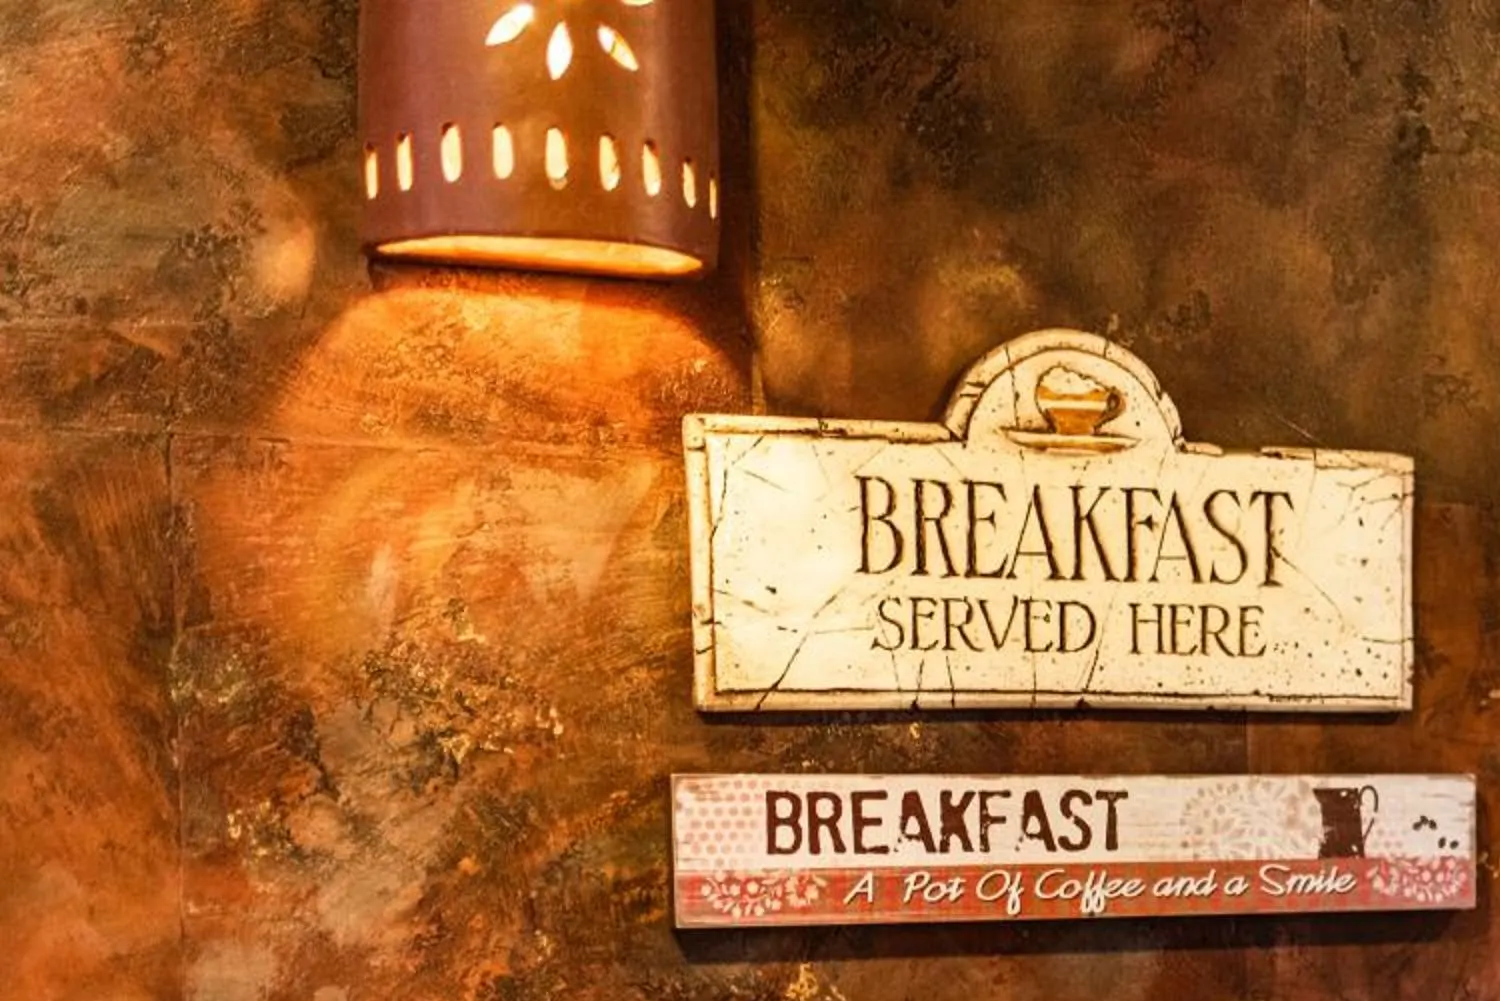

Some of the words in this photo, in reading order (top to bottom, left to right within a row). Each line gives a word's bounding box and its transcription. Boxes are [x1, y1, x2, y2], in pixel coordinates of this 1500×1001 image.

[854, 475, 1294, 587] BREAKFAST
[871, 596, 1097, 656] SERVED
[1128, 603, 1267, 659] HERE
[765, 789, 1129, 855] BREAKFAST
[844, 873, 877, 904] A
[901, 870, 966, 902] Pot
[975, 869, 1025, 914] Of
[1033, 867, 1145, 913] Coffee
[1152, 868, 1217, 898] and
[1223, 876, 1249, 898] a
[1258, 864, 1357, 897] Smile
